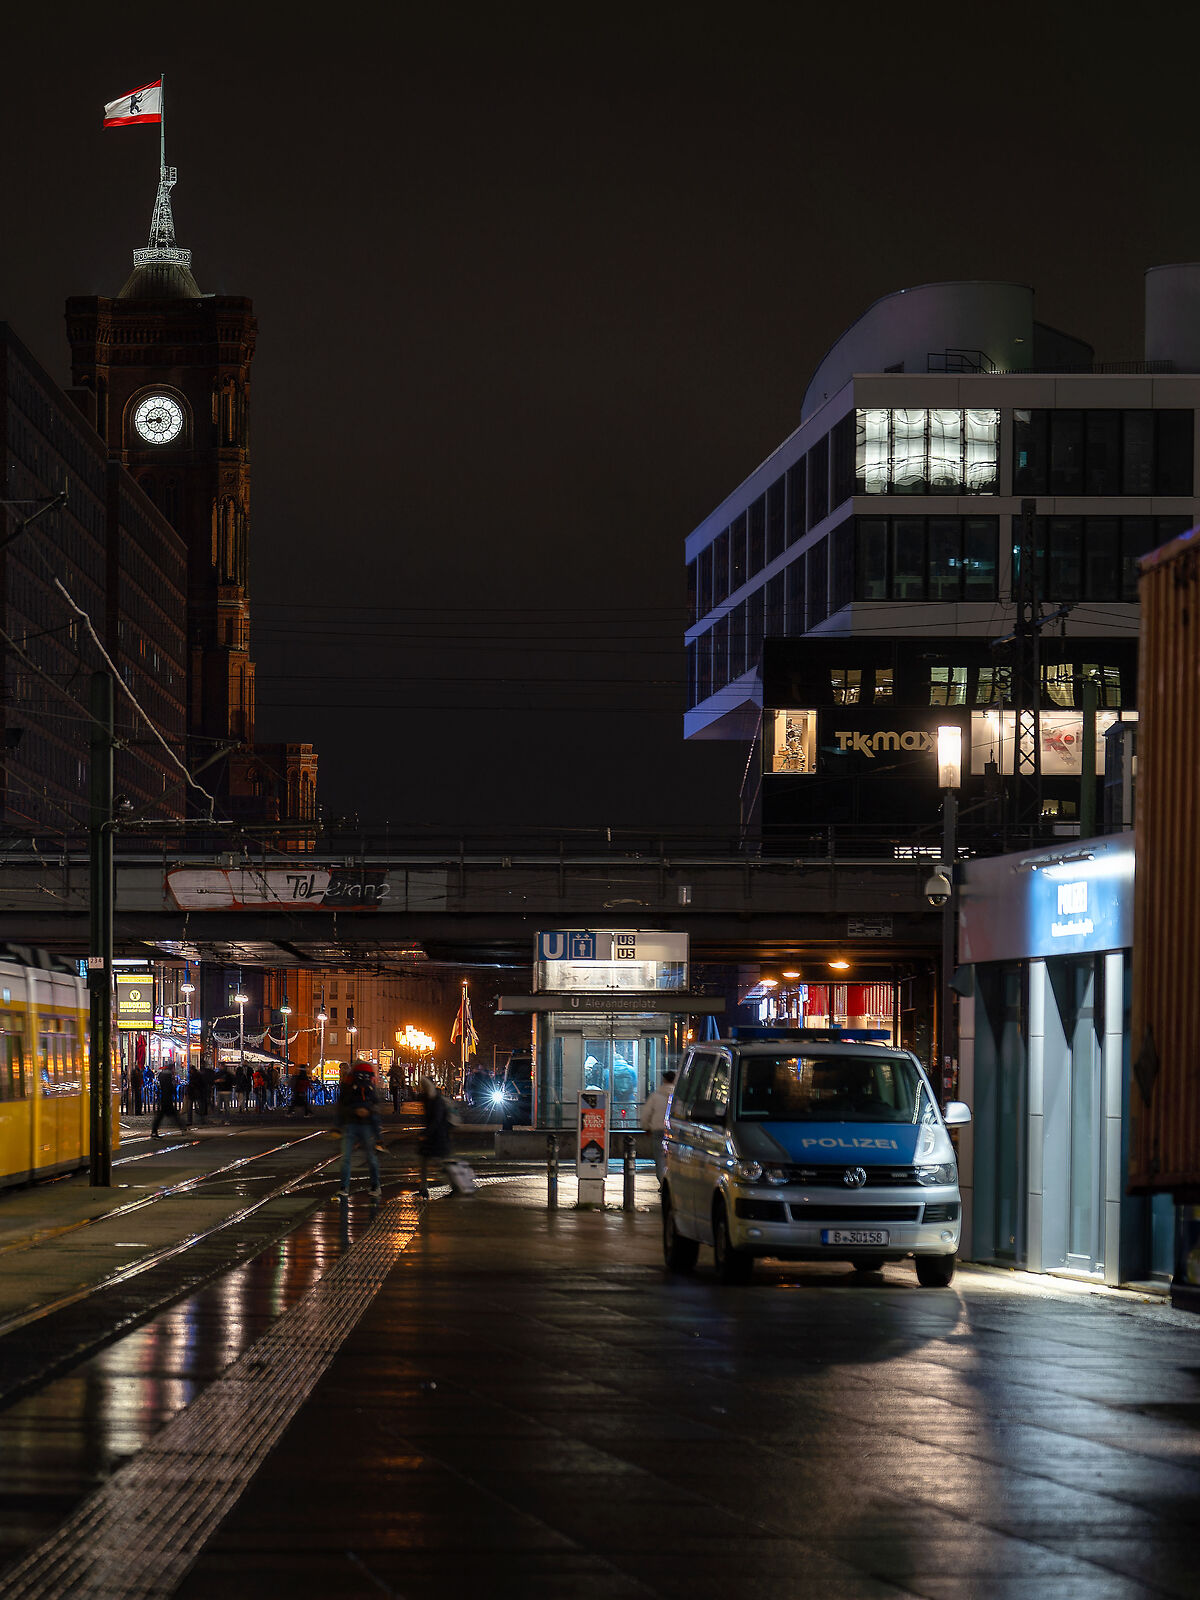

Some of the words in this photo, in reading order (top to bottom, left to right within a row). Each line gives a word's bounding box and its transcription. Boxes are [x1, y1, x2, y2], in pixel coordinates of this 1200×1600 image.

[542, 933, 564, 959] U
[618, 934, 635, 946] U8
[618, 949, 635, 960] U5
[571, 998, 580, 1008] U
[585, 998, 657, 1010] Alexanderplatz
[801, 1137, 899, 1150] POLIZEI
